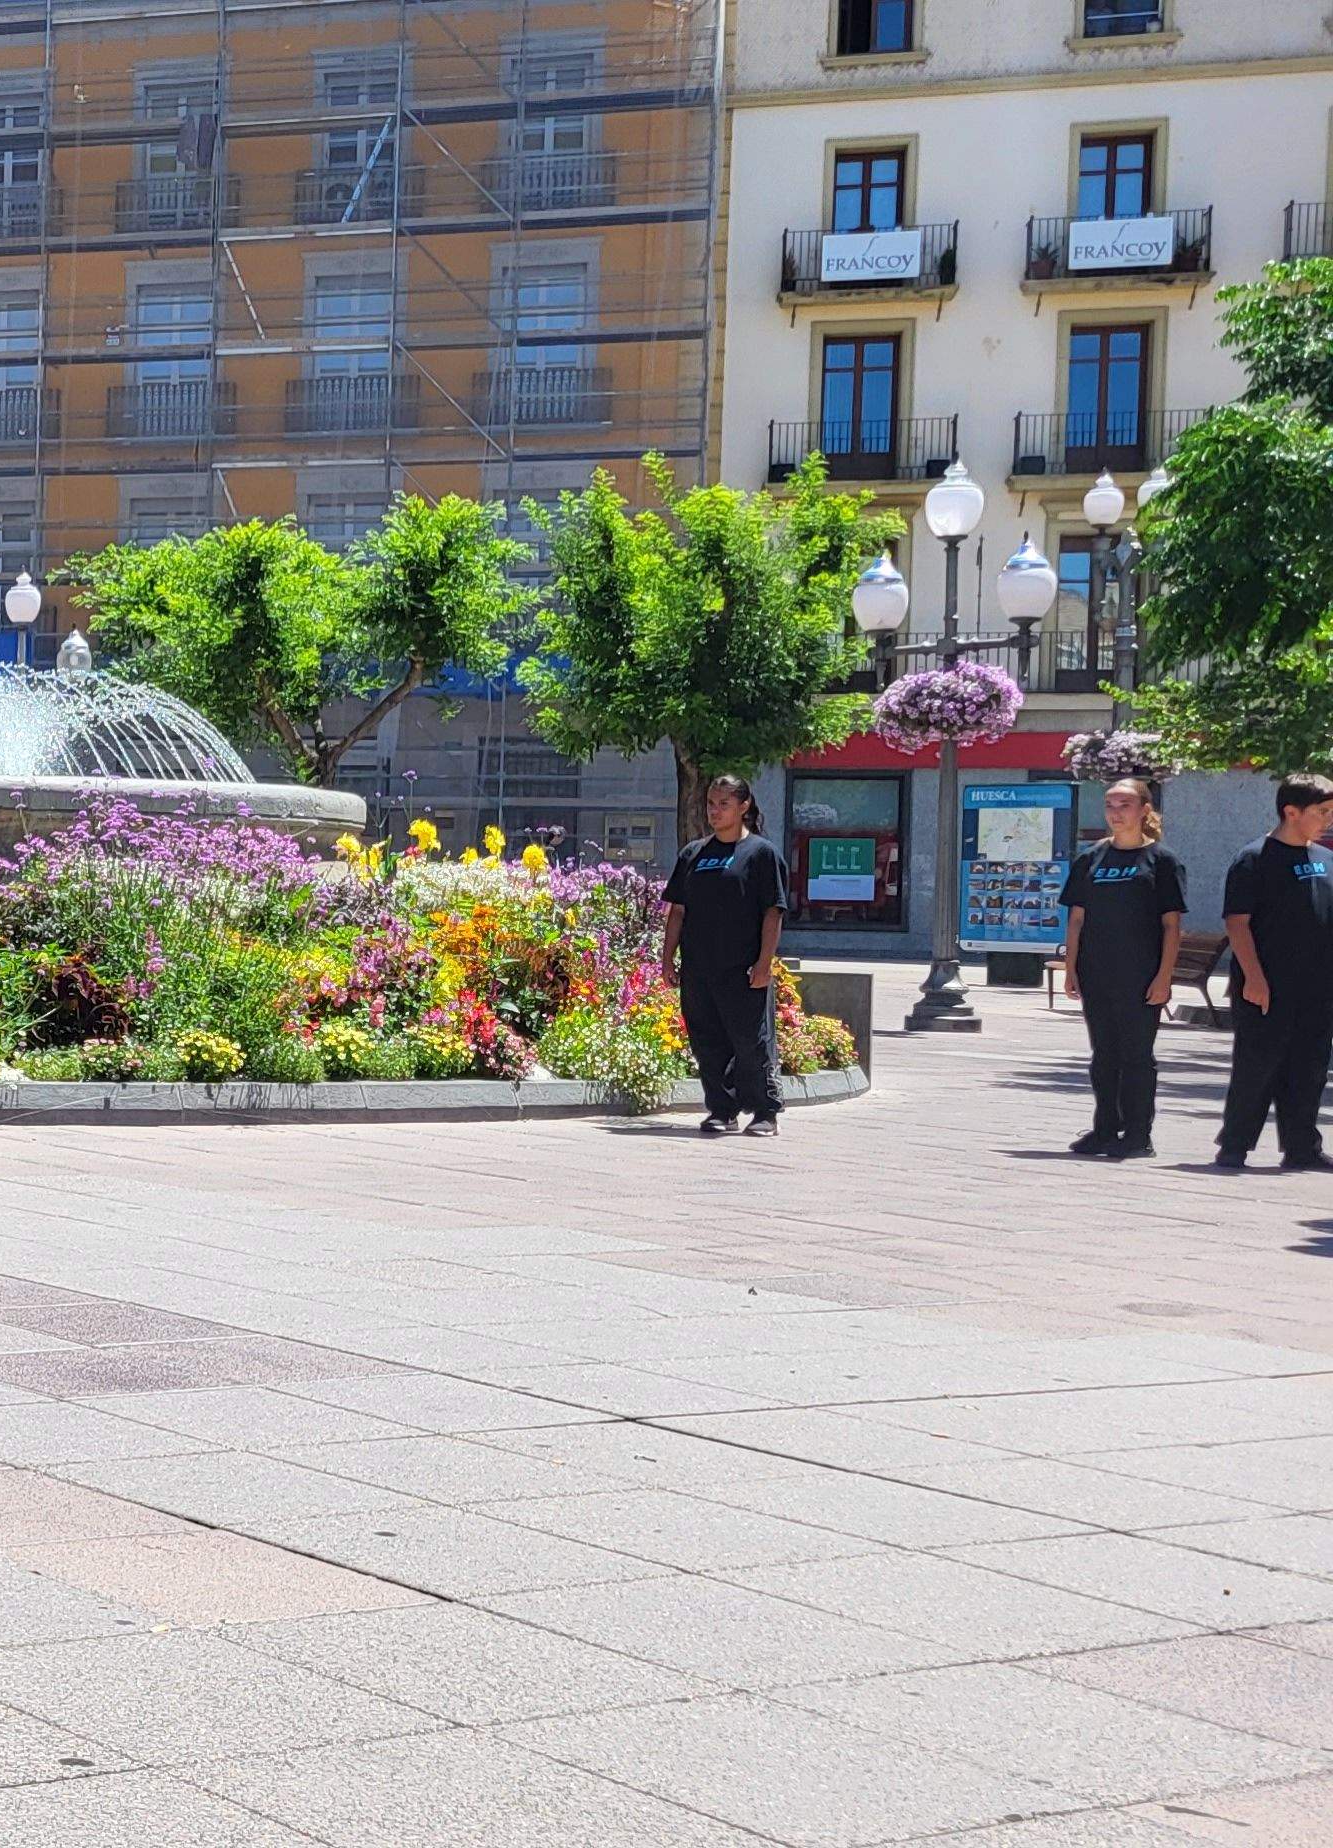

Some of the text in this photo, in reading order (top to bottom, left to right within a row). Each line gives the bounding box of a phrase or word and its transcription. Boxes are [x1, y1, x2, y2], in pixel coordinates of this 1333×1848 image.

[1074, 241, 1167, 262] FRANCOY
[825, 253, 915, 273] FRANCOY
[971, 790, 1016, 801] HUESCA
[1094, 866, 1138, 878] EDH
[1293, 862, 1325, 875] EDH
